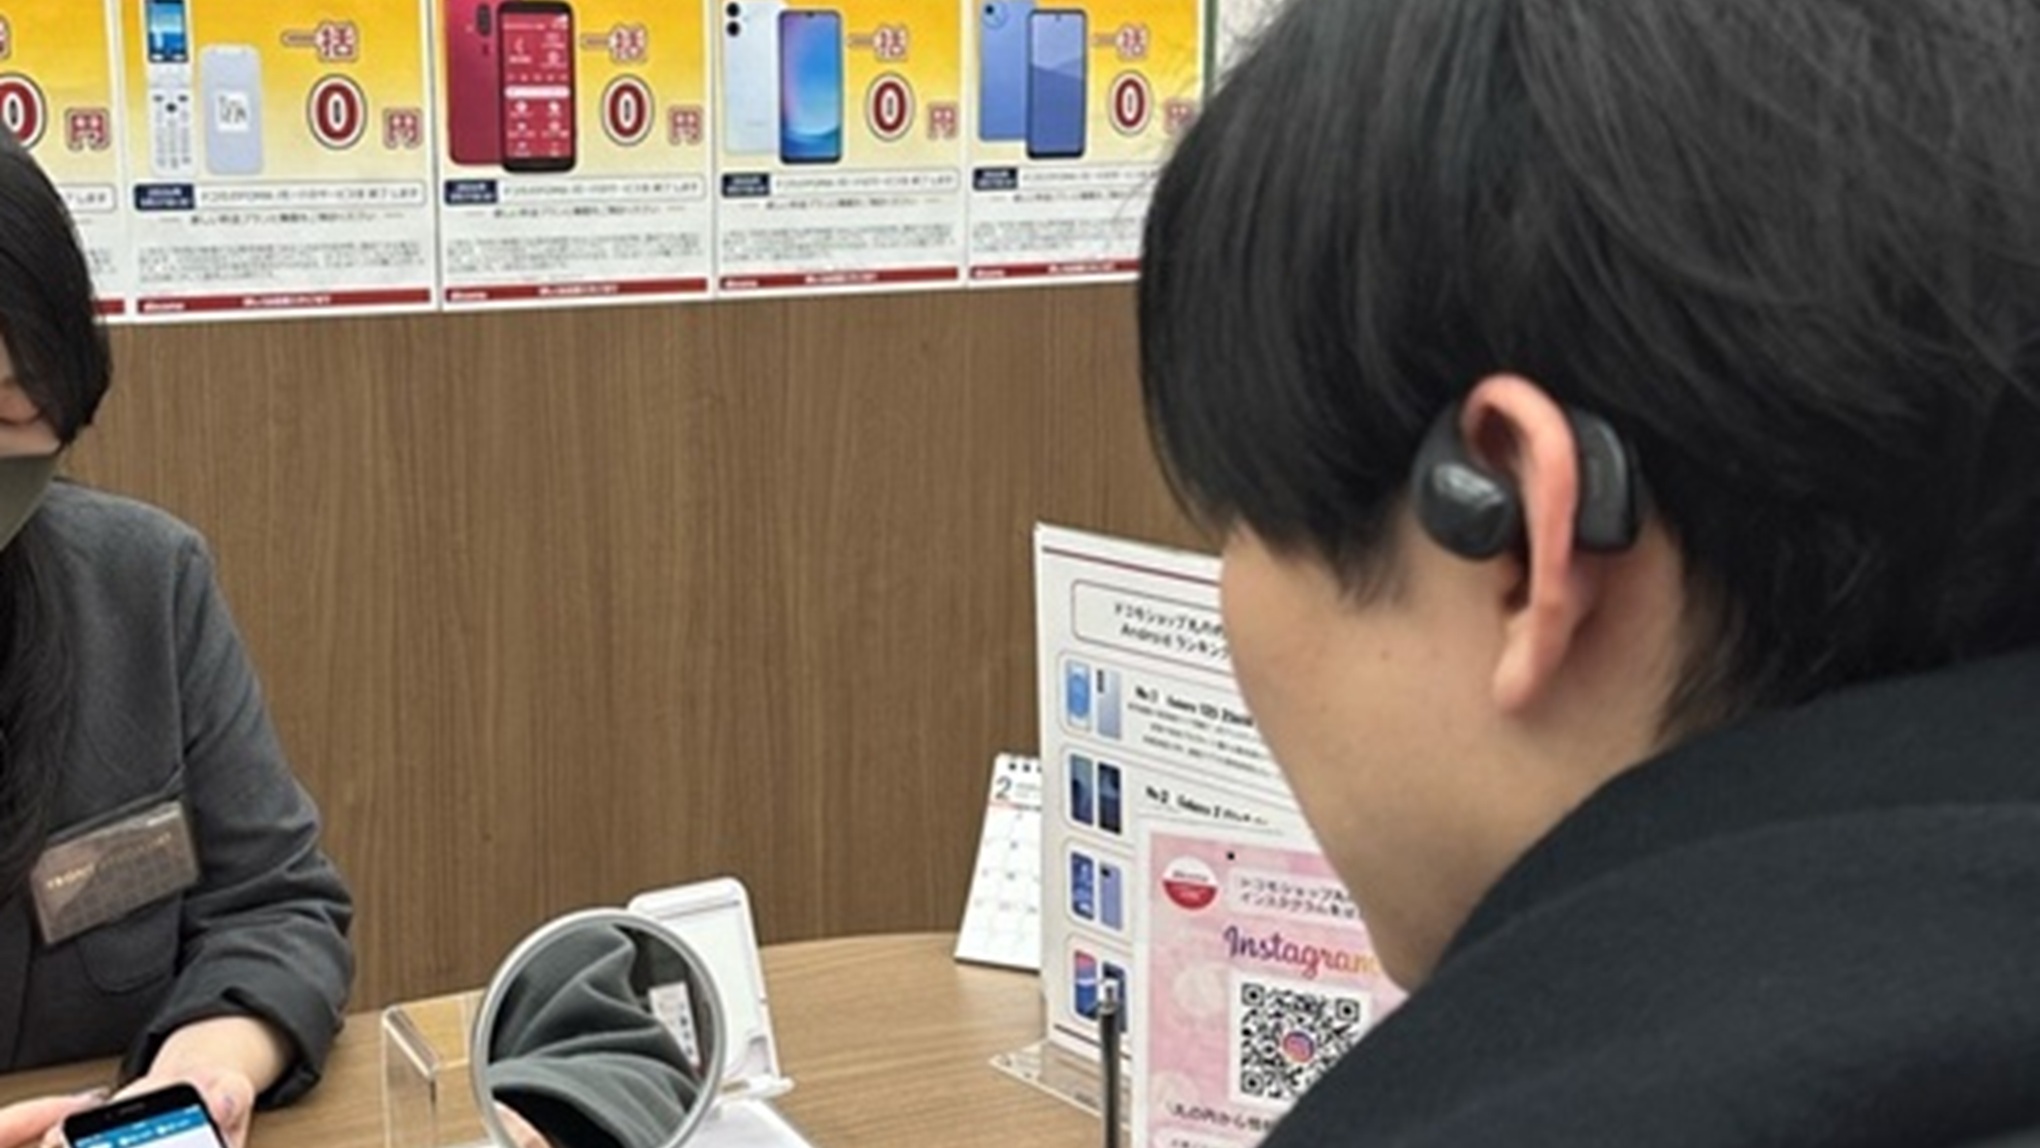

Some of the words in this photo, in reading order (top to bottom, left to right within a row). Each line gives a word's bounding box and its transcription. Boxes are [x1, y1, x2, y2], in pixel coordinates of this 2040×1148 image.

[281, 21, 358, 63] 一括
[580, 23, 648, 64] 一括
[849, 24, 908, 62] 一括
[1092, 24, 1148, 62] 一括
[307, 75, 367, 149] 0
[383, 108, 422, 148] 円
[601, 74, 654, 146] 0
[668, 105, 703, 146] 円
[865, 72, 915, 142] 0
[927, 102, 958, 139] 円
[1108, 70, 1152, 135] 0
[65, 107, 110, 151] 円
[995, 776, 1012, 800] 2
